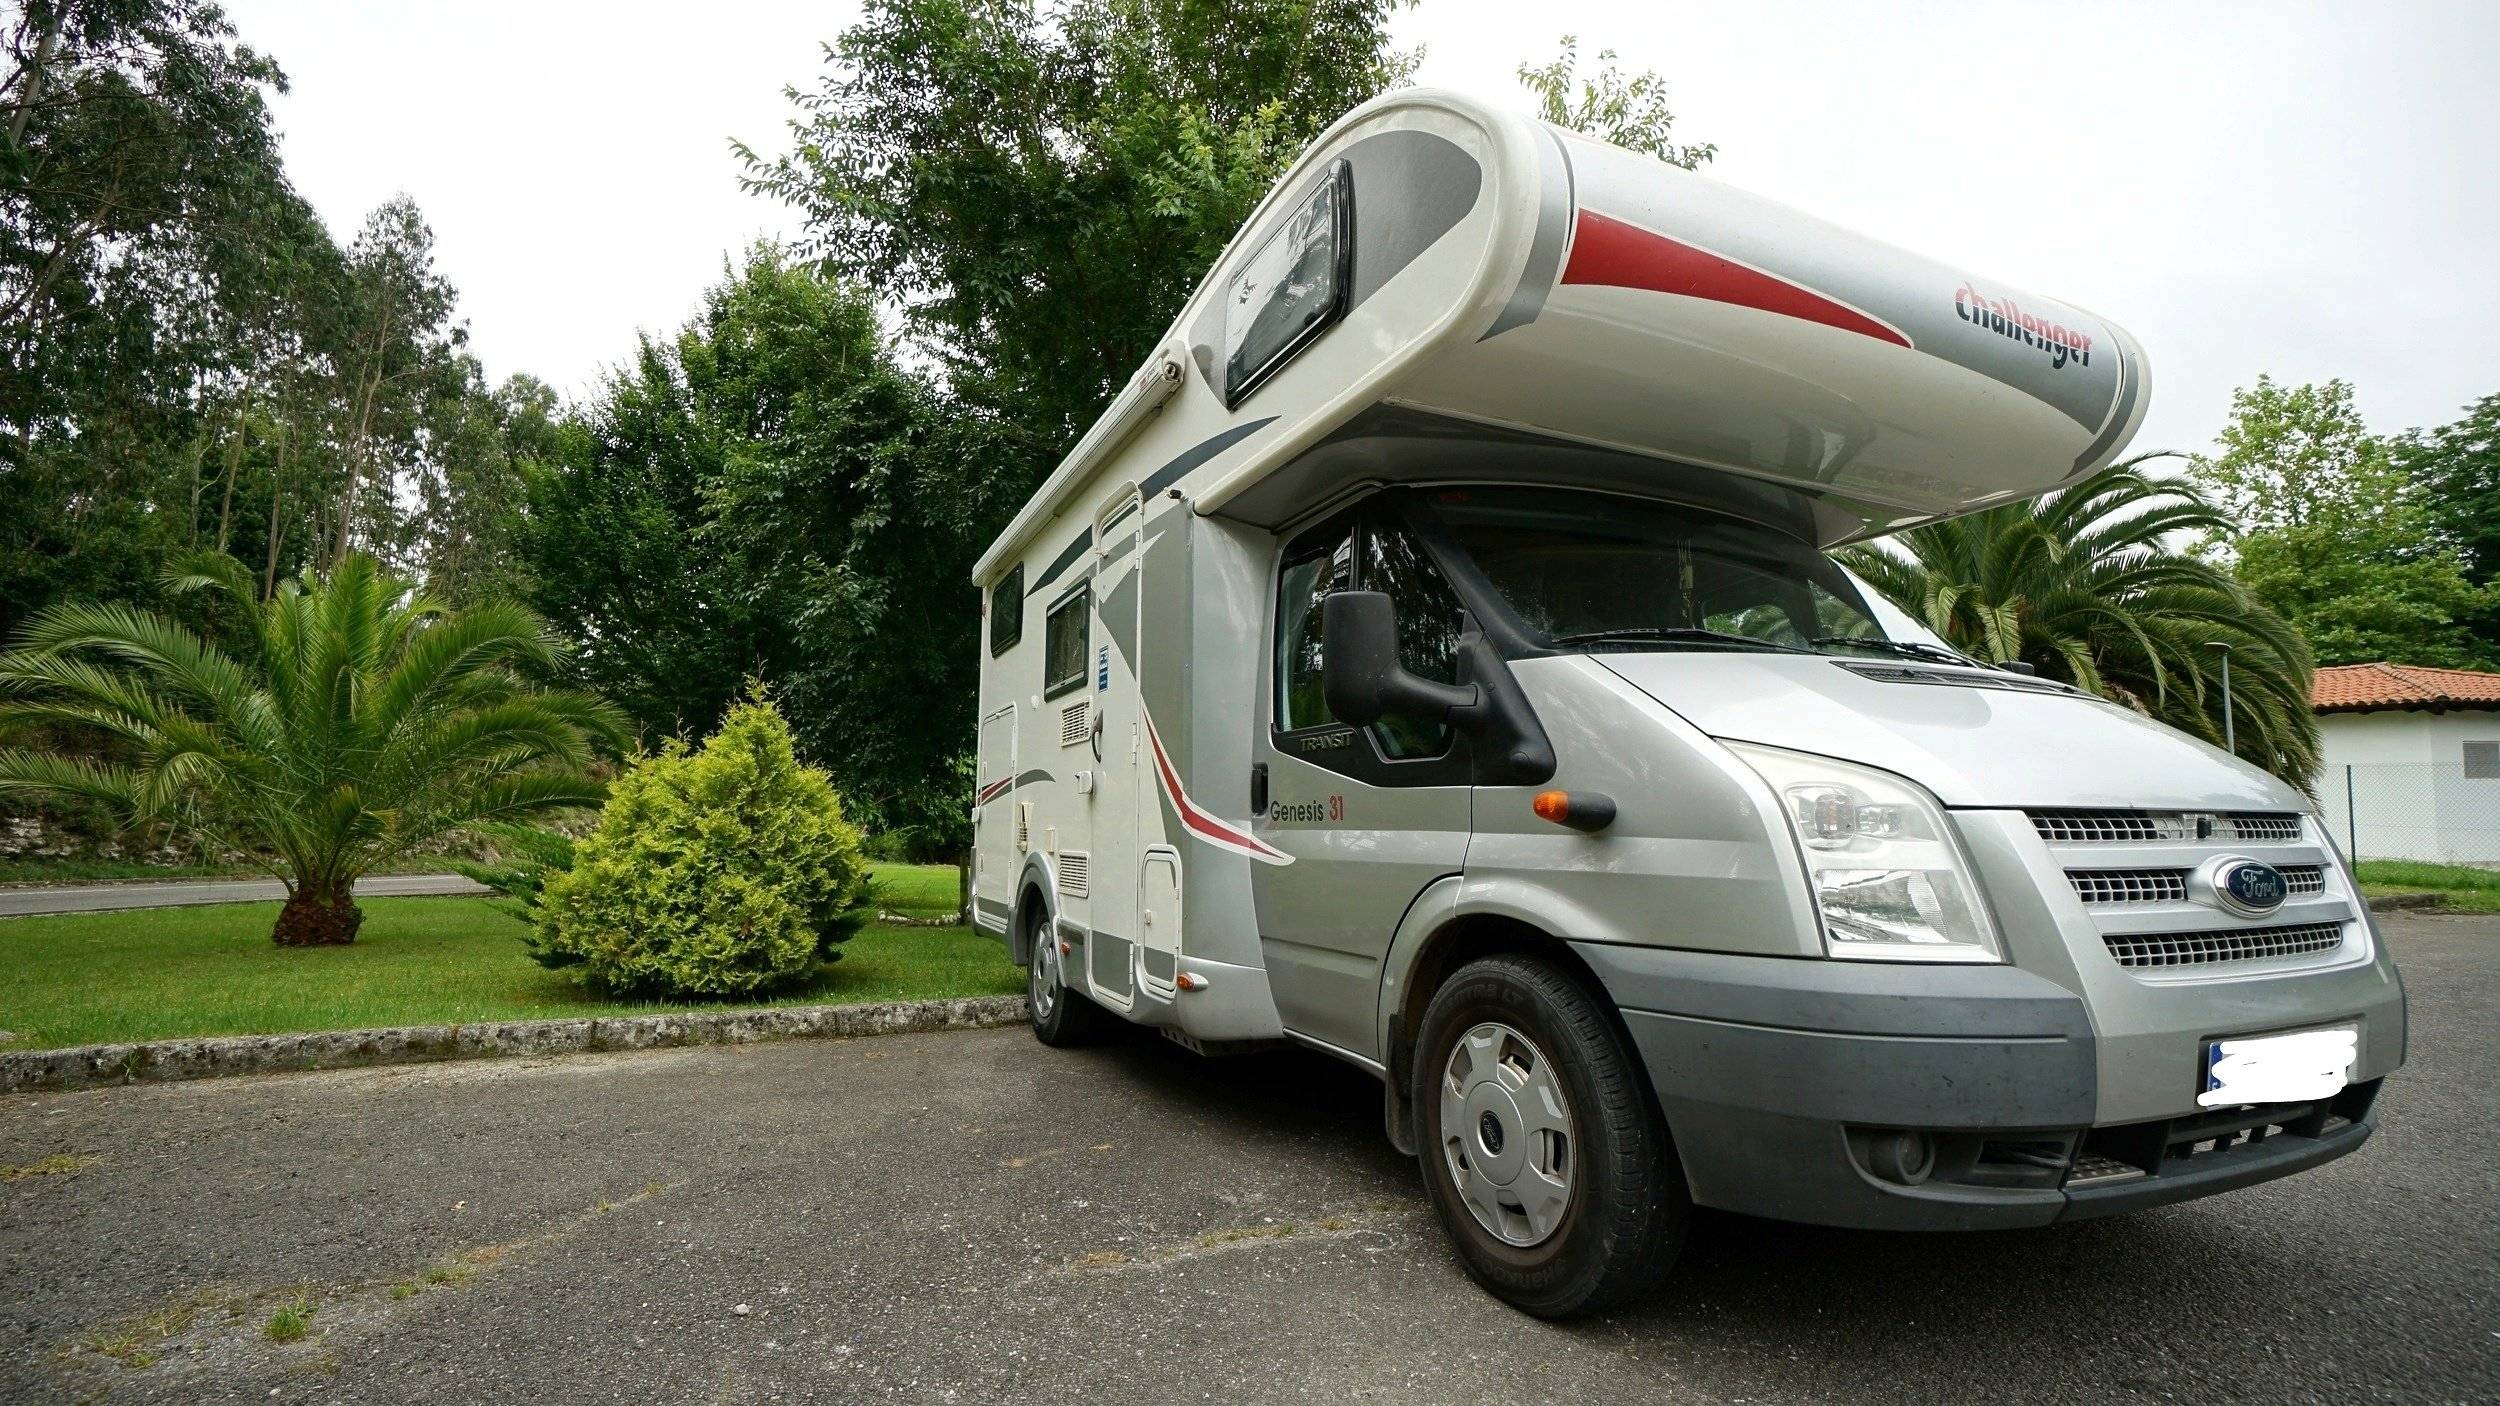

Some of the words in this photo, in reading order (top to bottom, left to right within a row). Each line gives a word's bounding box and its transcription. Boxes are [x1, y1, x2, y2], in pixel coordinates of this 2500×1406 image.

[1300, 731, 1353, 751] TRANSIT
[1270, 800, 1324, 822] Genesis
[1329, 795, 1344, 821] 31
[2241, 869, 2280, 898] Ford
